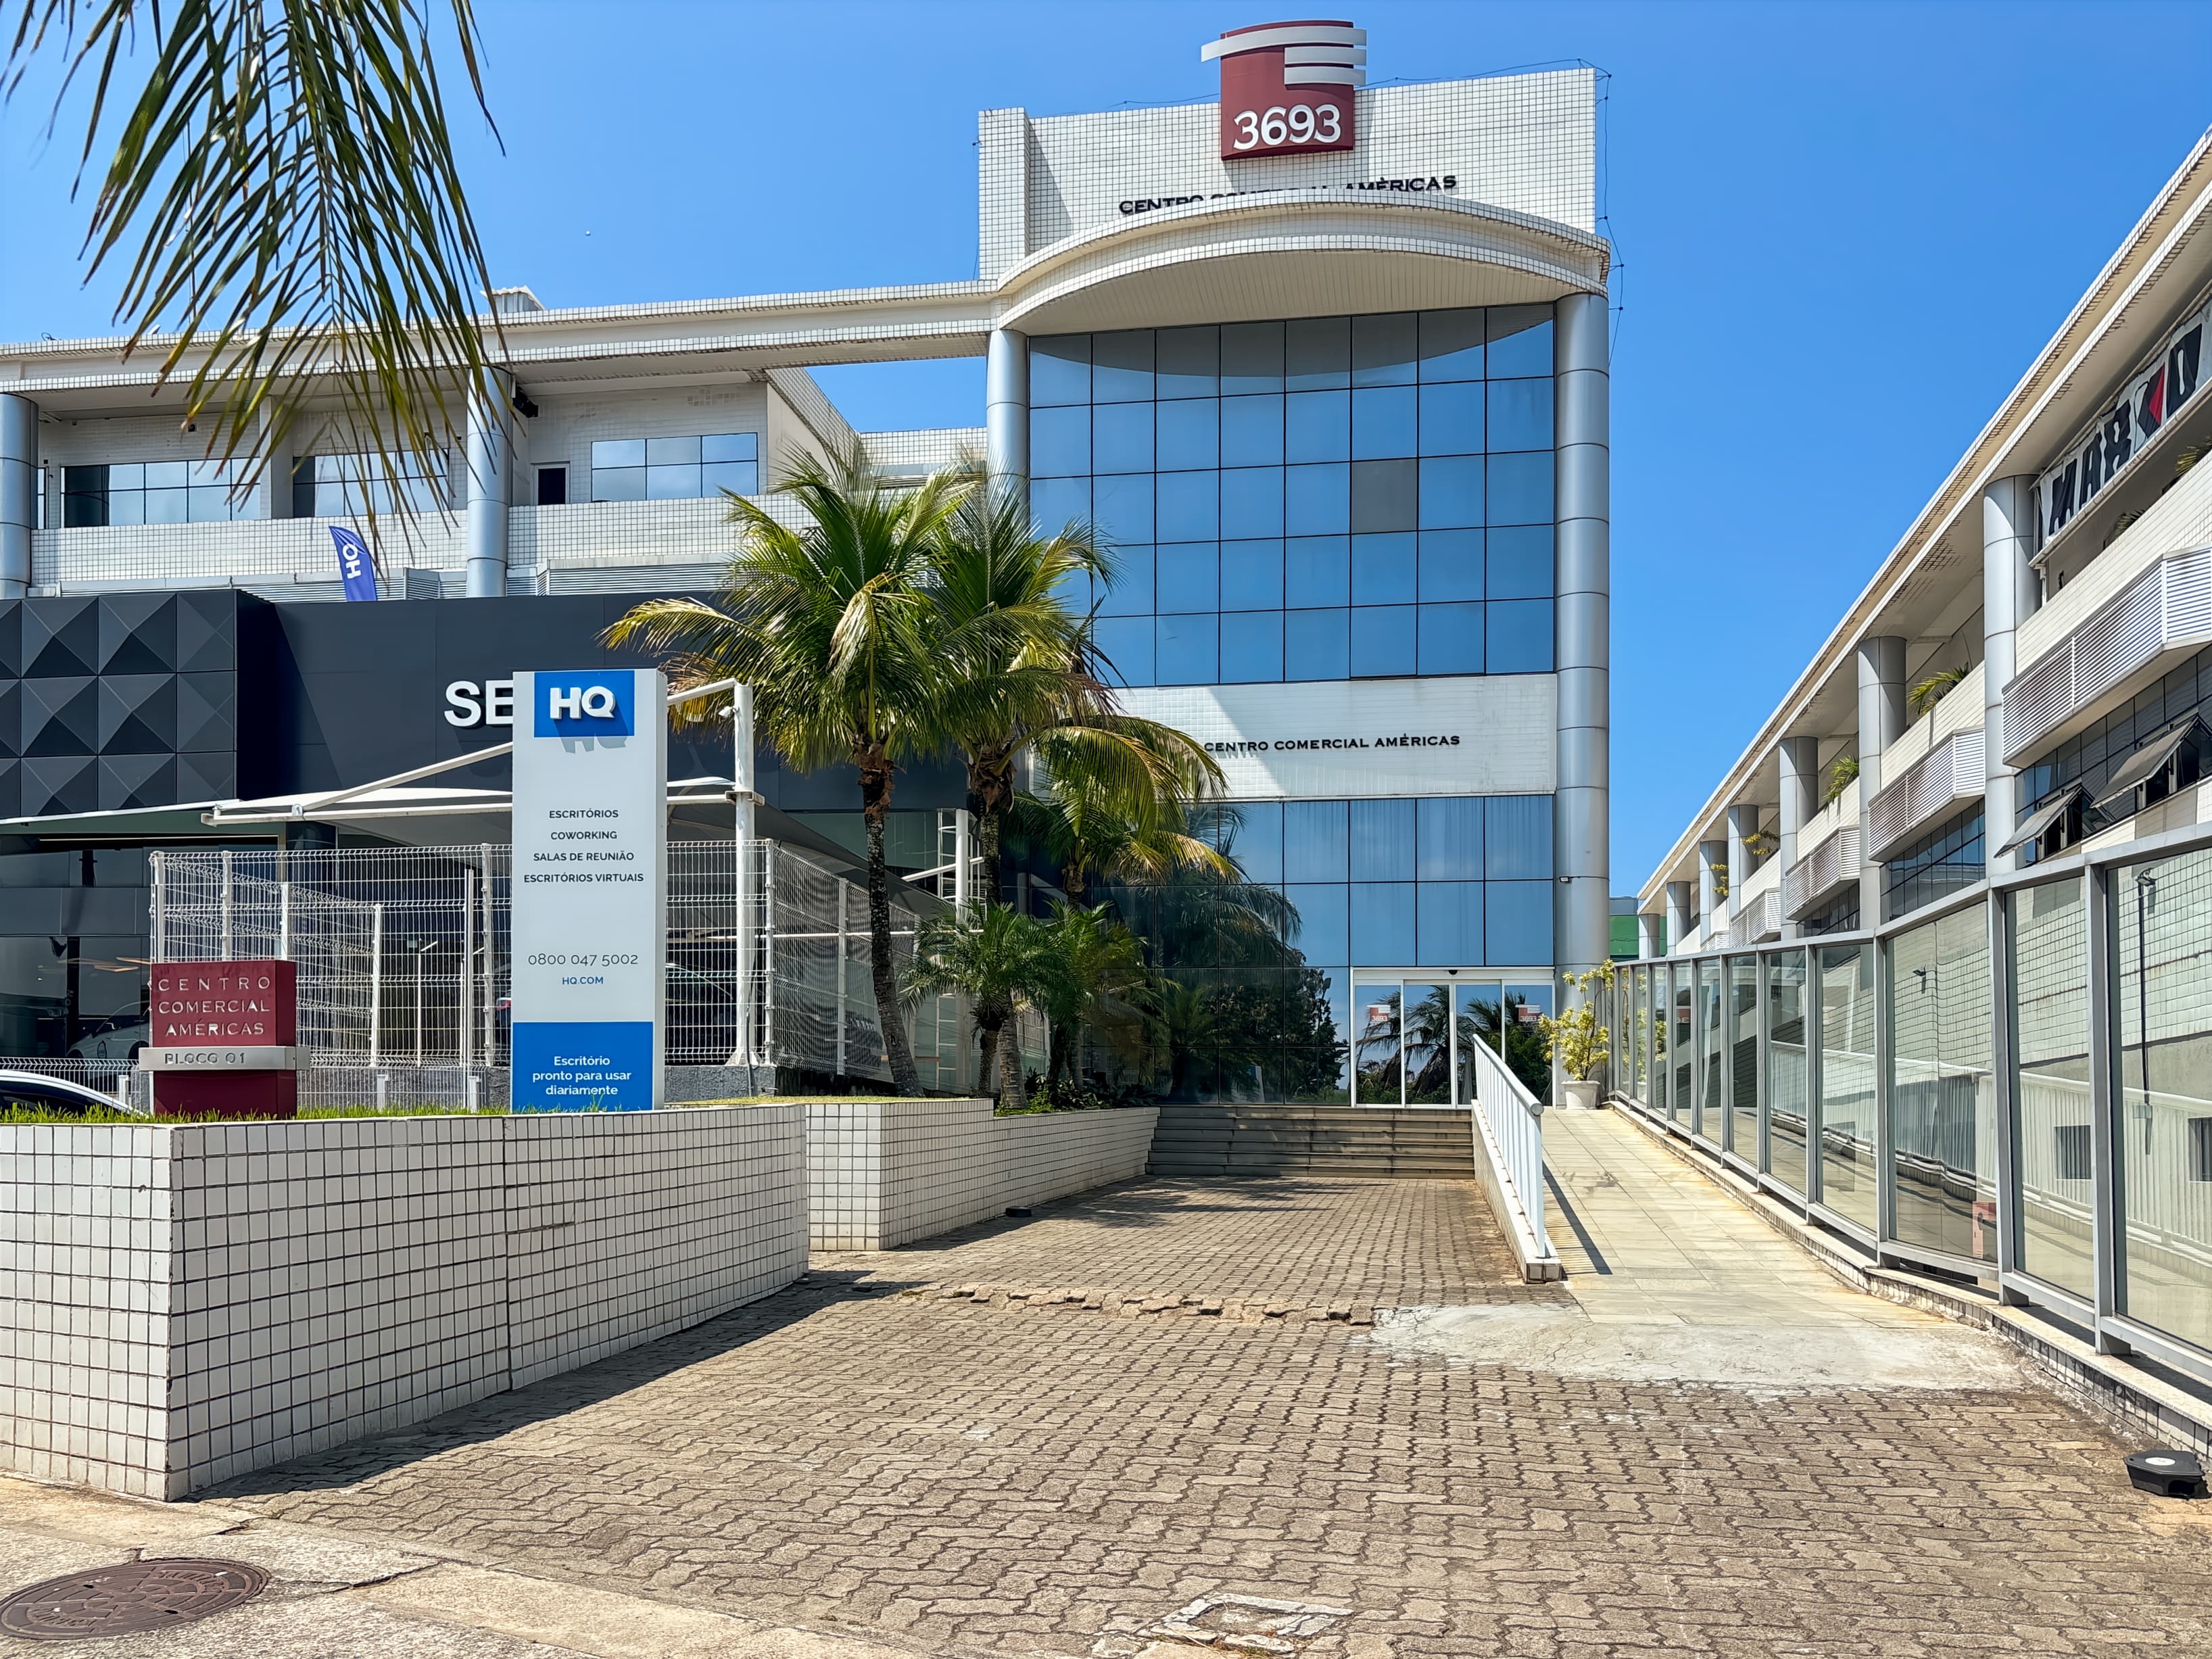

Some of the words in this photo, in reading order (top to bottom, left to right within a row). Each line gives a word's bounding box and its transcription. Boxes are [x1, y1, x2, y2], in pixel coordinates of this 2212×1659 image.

[1233, 103, 1341, 150] 3693
[342, 543, 362, 579] HQ
[444, 680, 513, 727] SE
[550, 686, 617, 719] HQ
[1204, 741, 1268, 752] CENTRO
[1274, 738, 1370, 750] COMERCIAL
[1374, 733, 1460, 747] AMÉRICAS
[549, 808, 619, 818] ESCRITÓRIOS
[550, 831, 617, 840] COWORKING
[533, 852, 567, 861] SALAS
[569, 852, 583, 861] DE
[586, 850, 634, 861] REUNIÃO
[524, 872, 593, 883] ESCRITÓRIOS
[595, 873, 644, 882] VIRTUAIS
[528, 953, 566, 965] 0800
[571, 955, 597, 966] 047
[602, 955, 639, 967] 5002
[158, 977, 270, 991] CENTRO
[562, 976, 604, 985] HQ.COM
[158, 1000, 270, 1013] COMERCIAL
[165, 1017, 264, 1036] AMÉRICAS
[164, 1053, 218, 1065] BLOCO
[225, 1052, 245, 1064] 01
[554, 1056, 610, 1066] Escritório
[532, 1071, 573, 1083] pronto
[575, 1073, 601, 1083] para
[605, 1072, 632, 1080] usar
[546, 1084, 618, 1095] diariamente
